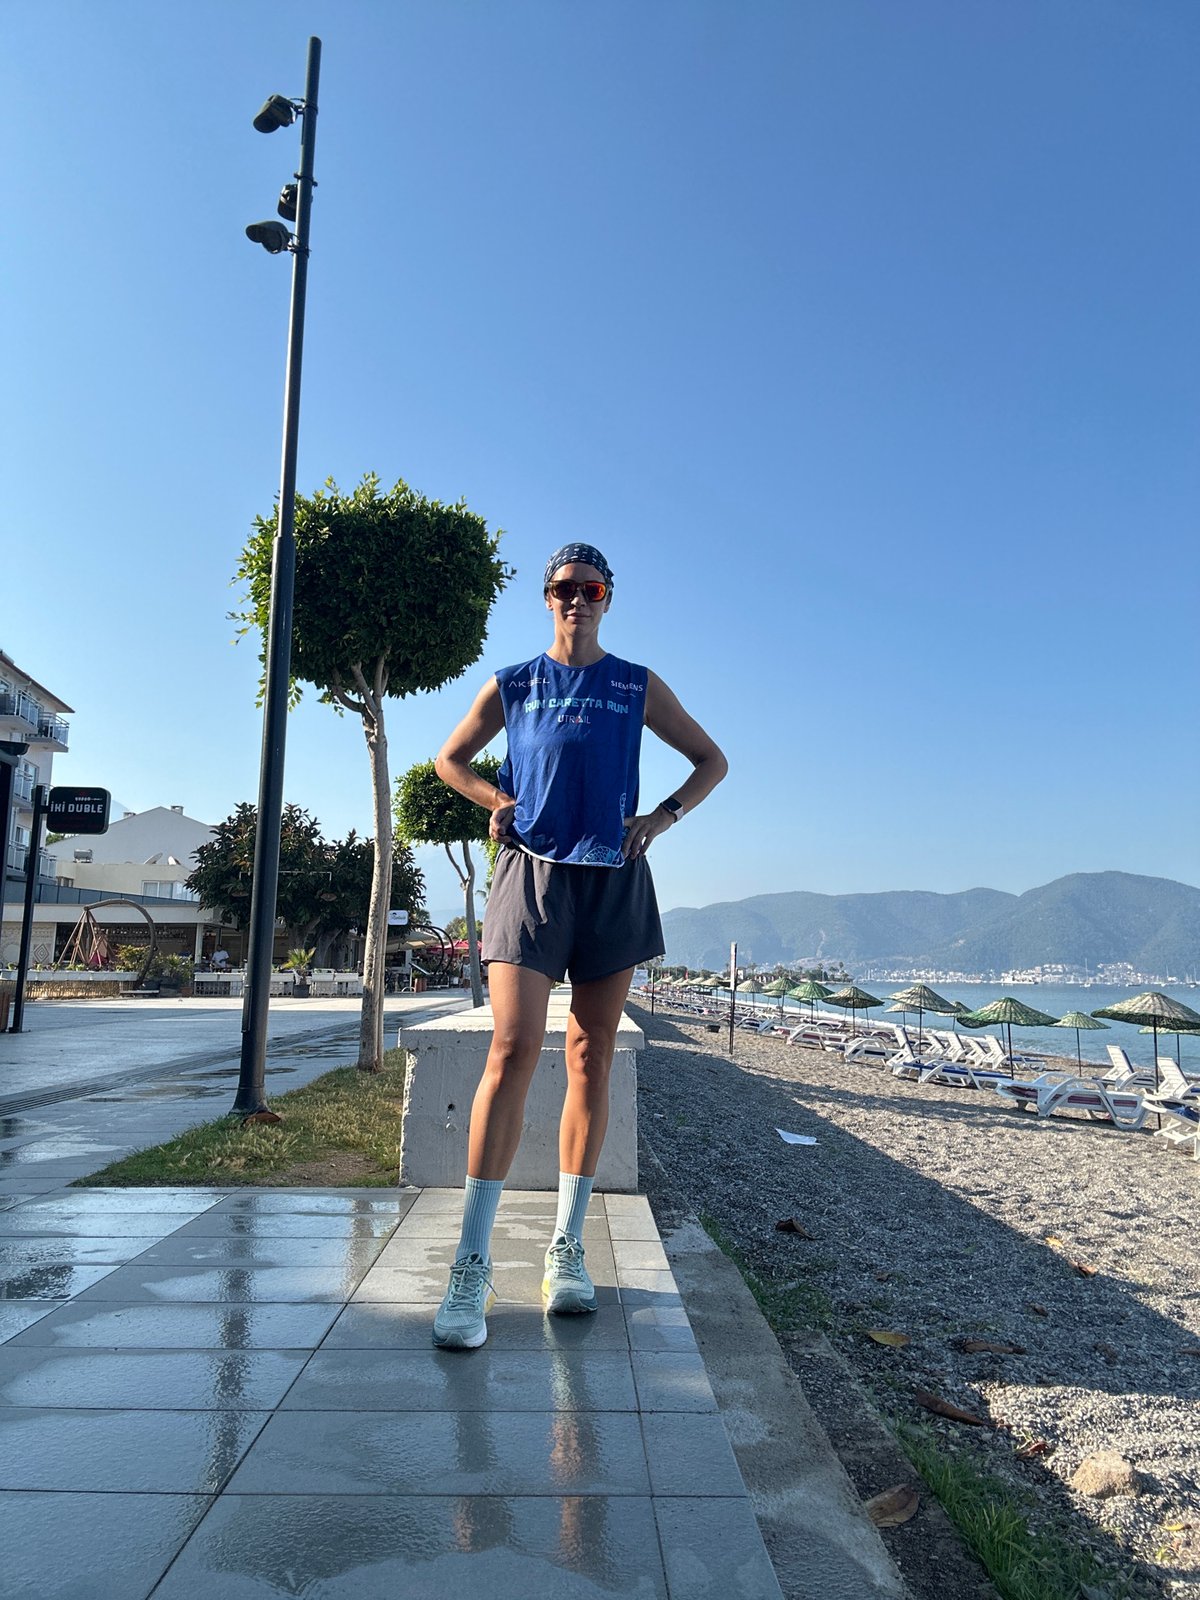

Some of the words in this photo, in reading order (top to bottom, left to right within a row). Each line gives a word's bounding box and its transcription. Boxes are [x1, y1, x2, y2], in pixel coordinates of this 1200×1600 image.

[610, 680, 643, 692] SIEMENS
[525, 698, 546, 714] RUN
[548, 697, 605, 709] CARETTA
[606, 700, 629, 714] RUN
[50, 801, 66, 812] İKİ
[68, 803, 103, 813] DUBLE
